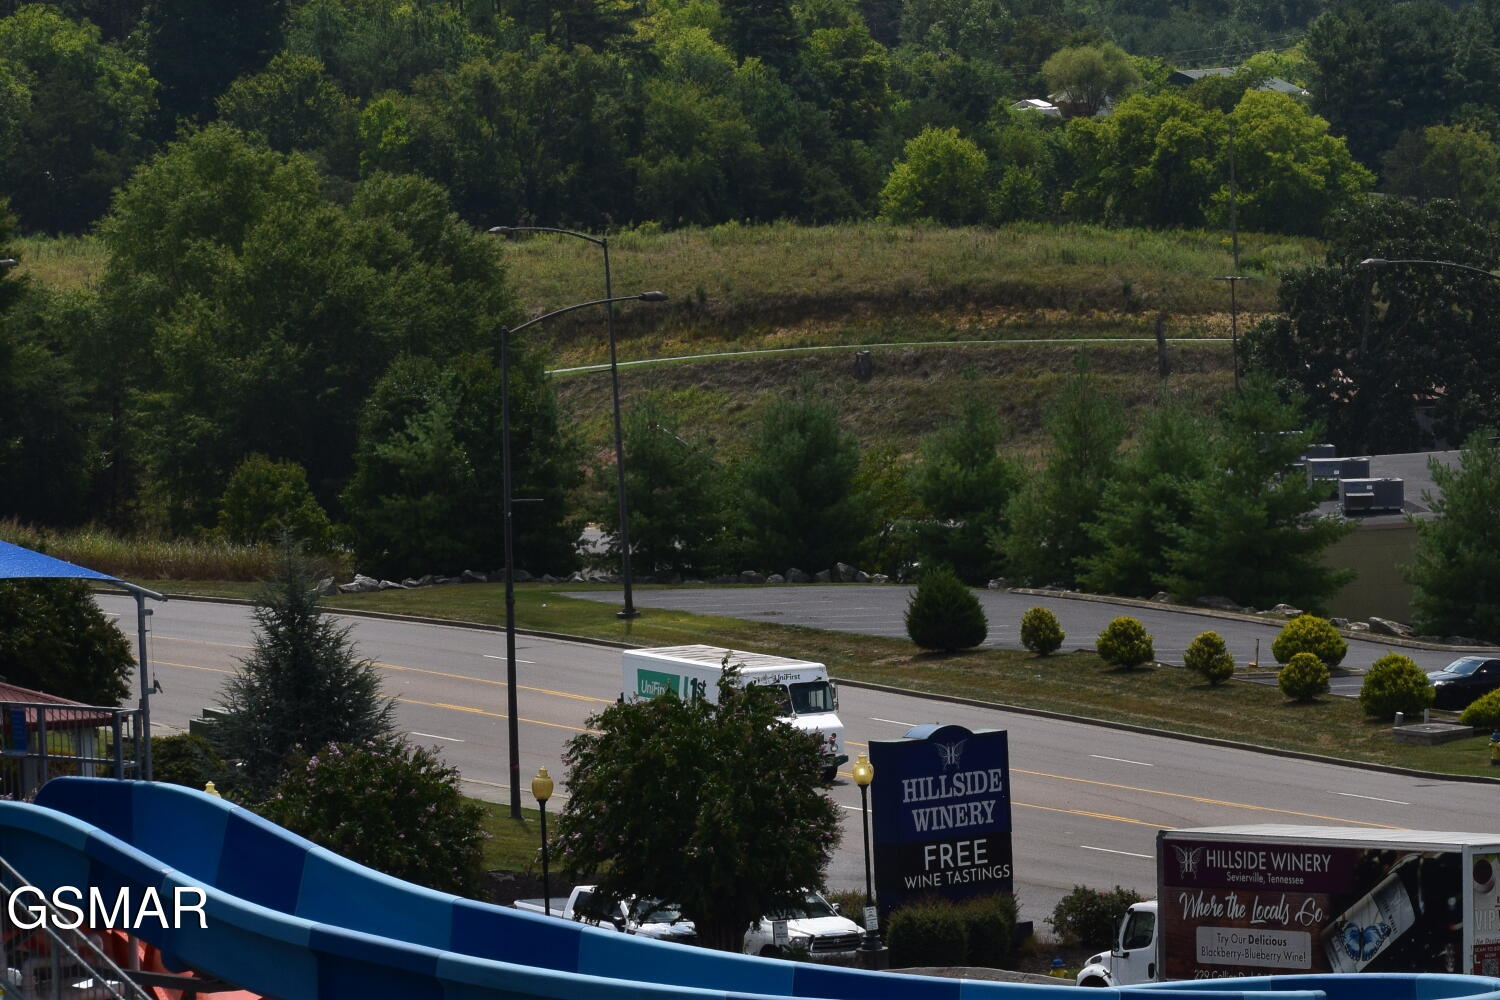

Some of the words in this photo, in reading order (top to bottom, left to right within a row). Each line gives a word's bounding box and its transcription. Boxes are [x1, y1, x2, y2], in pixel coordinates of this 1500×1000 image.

[902, 768, 1003, 803] HILLSIDE
[912, 800, 996, 832] WINERY
[924, 839, 988, 871] FREE
[1206, 849, 1267, 870] HILLSIDE
[1271, 852, 1332, 873] WINERY
[904, 872, 942, 889] WINE
[946, 864, 1010, 885] TASTINGS
[1226, 871, 1266, 884] Sevierville,
[1267, 873, 1305, 885] Tennessee
[1179, 890, 1223, 921] Where
[1225, 891, 1246, 920] the
[1250, 893, 1290, 926] Locals
[1295, 897, 1323, 927] Go
[1474, 908, 1496, 930] VIP
[1217, 933, 1229, 946] Try
[1231, 933, 1247, 944] Our
[1248, 934, 1287, 947] Delicious
[1201, 946, 1282, 963] Blackberry-Blueberry
[1282, 950, 1306, 963] Wine!
